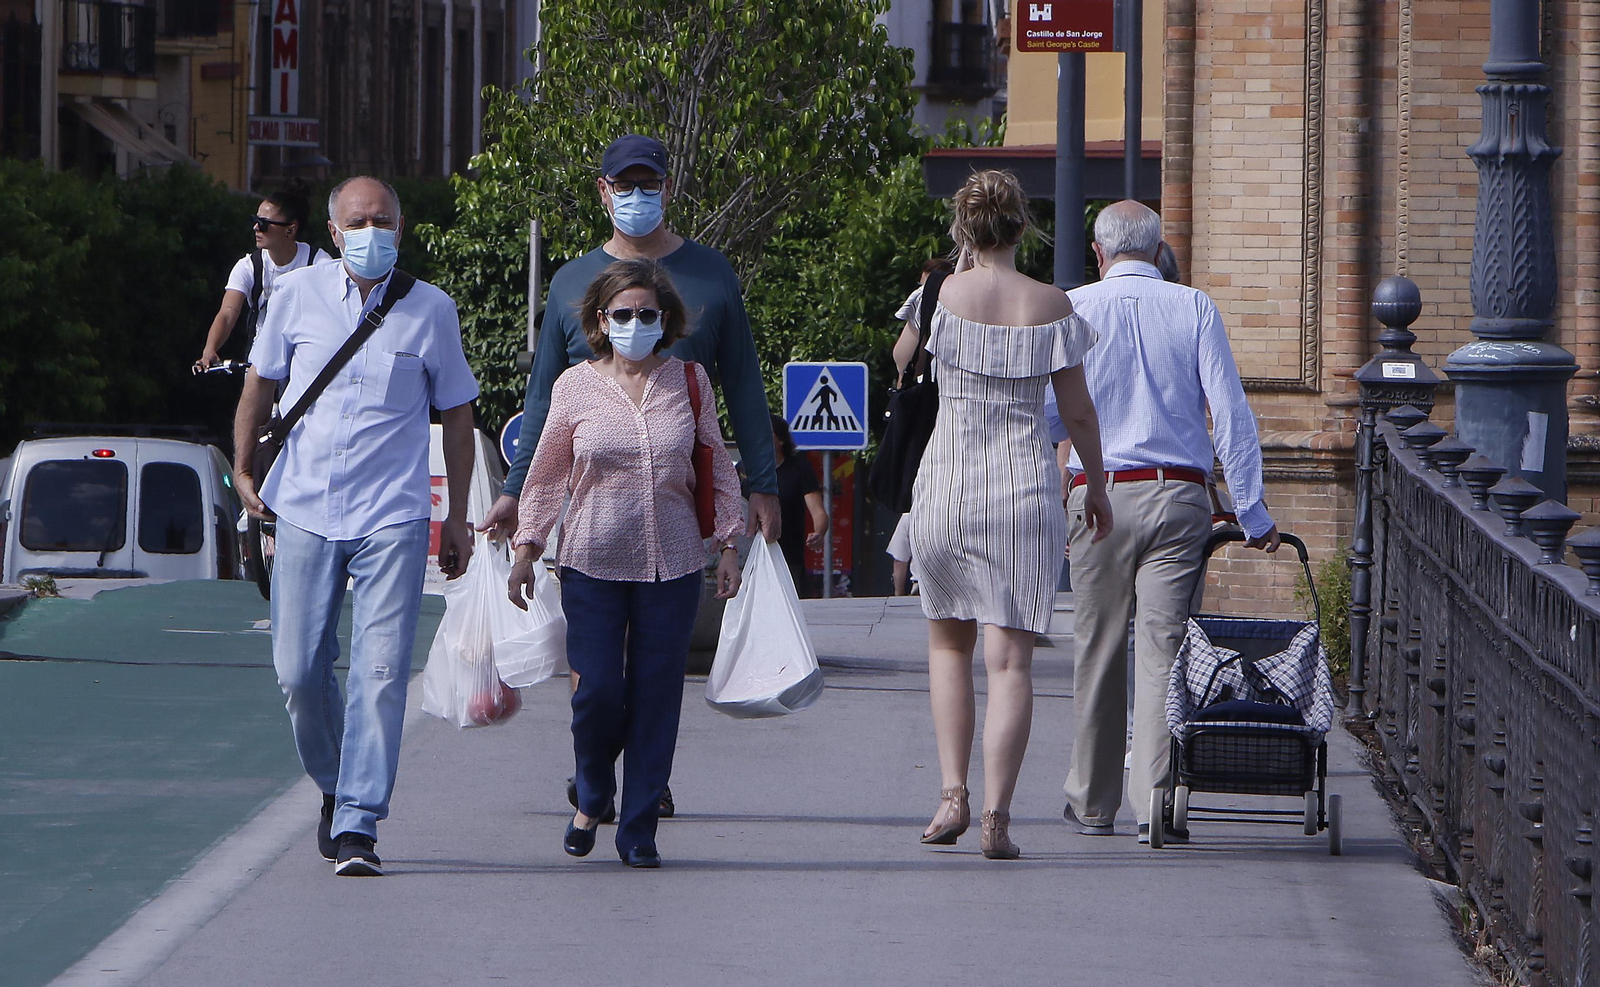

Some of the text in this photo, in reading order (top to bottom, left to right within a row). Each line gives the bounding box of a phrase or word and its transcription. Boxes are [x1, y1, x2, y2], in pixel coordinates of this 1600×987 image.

[1026, 30, 1103, 39] Castillo de San Jorge
[1027, 40, 1100, 49] Saint George's Castle
